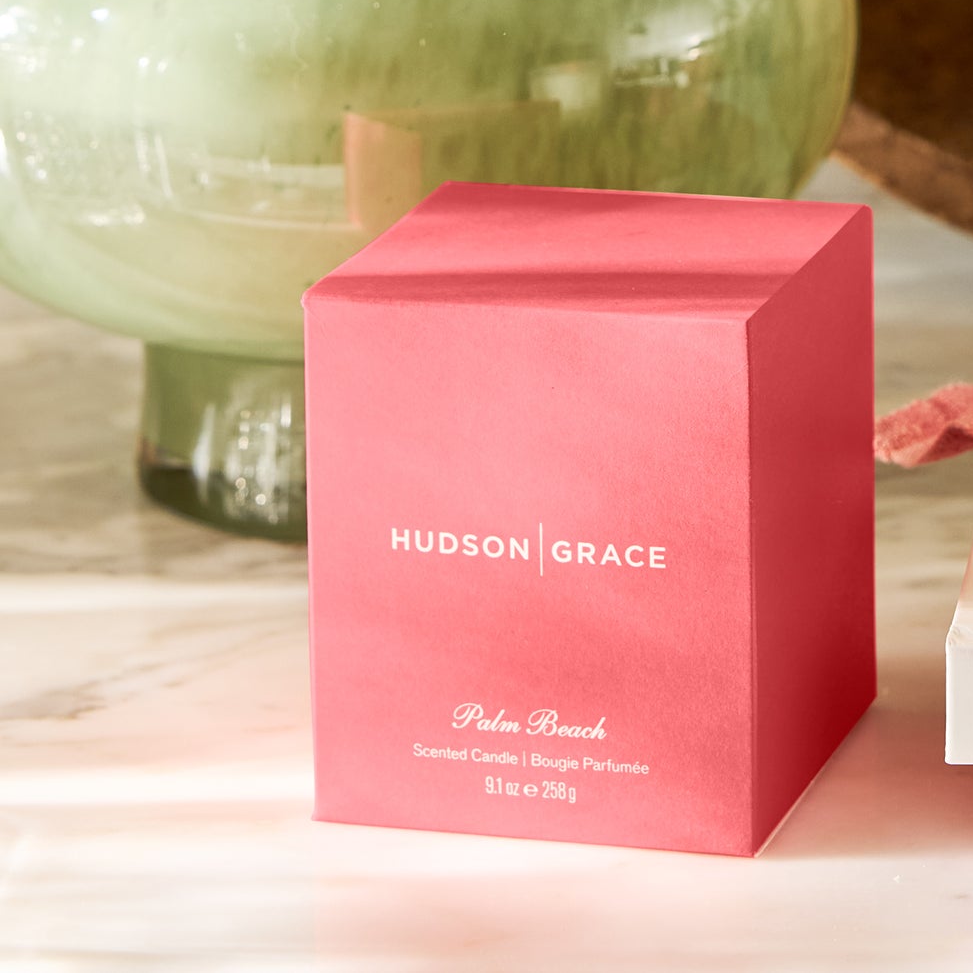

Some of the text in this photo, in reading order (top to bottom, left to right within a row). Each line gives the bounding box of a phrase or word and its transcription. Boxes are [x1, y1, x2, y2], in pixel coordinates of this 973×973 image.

[390, 527, 667, 569] HUDSON GRACE
[451, 702, 607, 740] Palm Beach
[412, 742, 650, 775] Scented Candle Bougie Parfumée
[485, 775, 502, 795] 9.1
[505, 782, 520, 796] oz
[542, 780, 567, 800] 258
[568, 787, 577, 804] g
